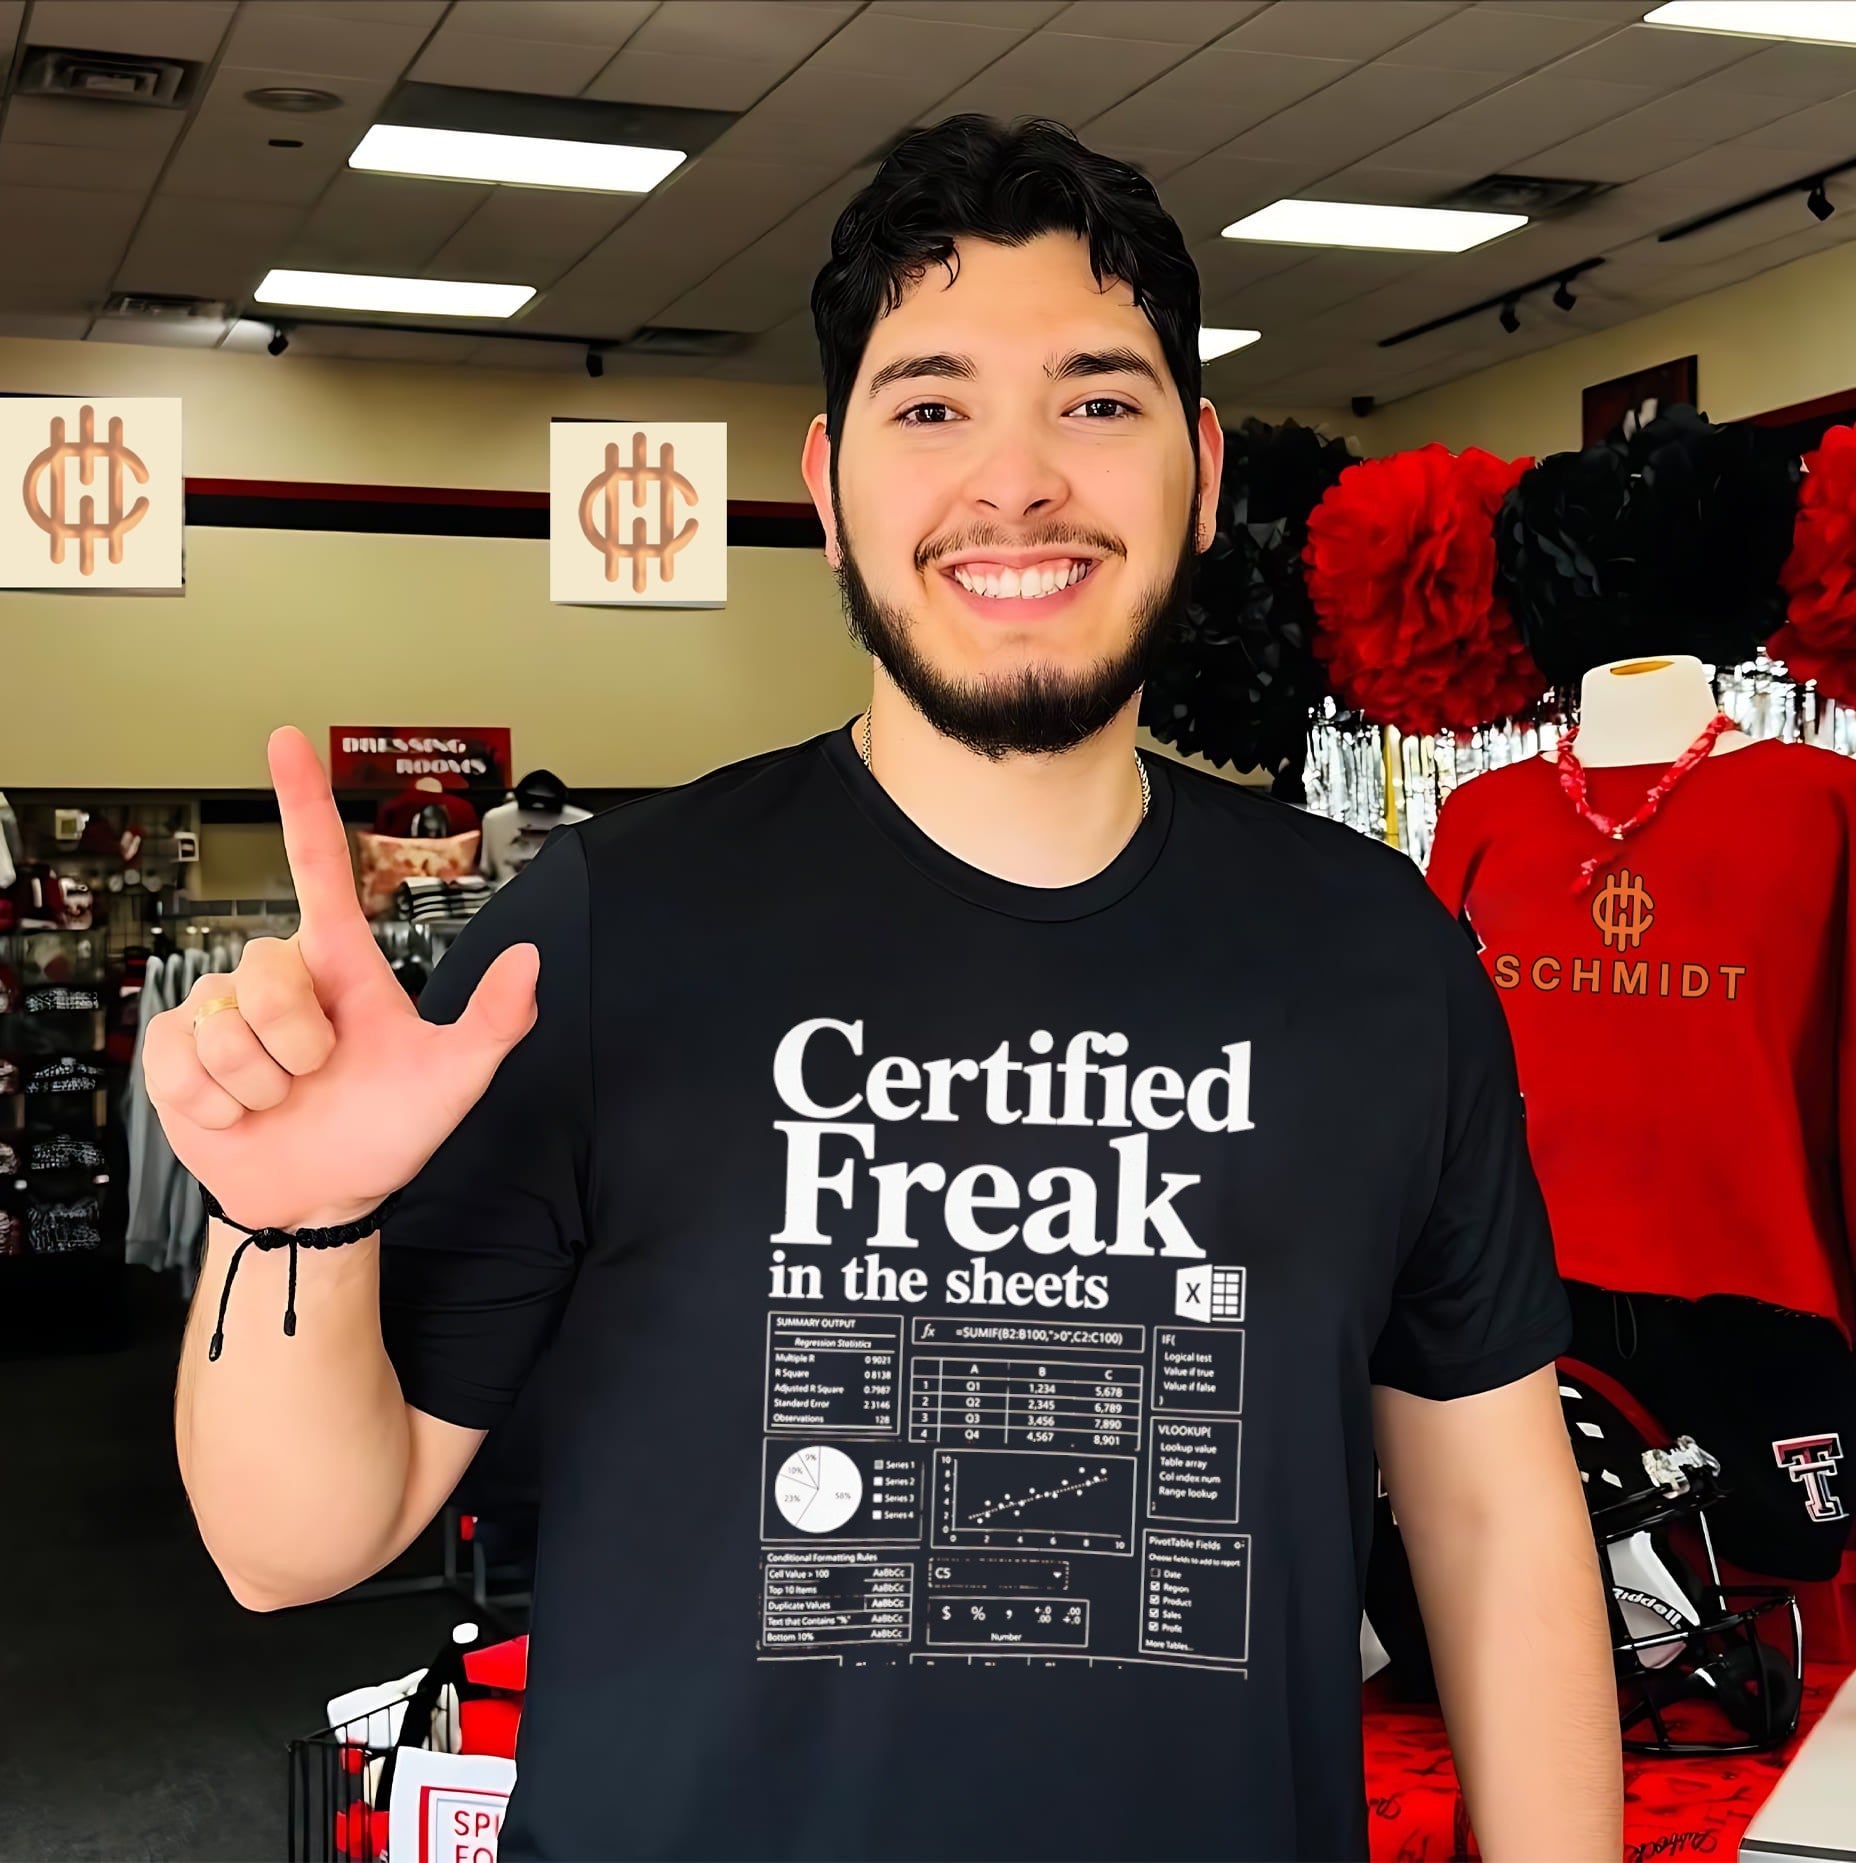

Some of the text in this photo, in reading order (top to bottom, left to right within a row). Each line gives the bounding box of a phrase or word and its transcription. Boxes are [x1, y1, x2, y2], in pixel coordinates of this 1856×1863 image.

[396, 758, 487, 775] ROOMS
[1494, 954, 1746, 1000] SCHMIDT
[773, 1018, 1255, 1133] Certified
[770, 1121, 1206, 1258] Freak
[769, 1251, 1108, 1309] in the sheets
[1185, 1282, 1201, 1304] X
[776, 1318, 856, 1329] SUMMARY OUTPUT
[795, 1338, 872, 1349] Regression Statistics
[1162, 1334, 1176, 1346] IF(
[775, 1354, 891, 1364] Multiple R 09021
[1164, 1352, 1212, 1363] Logical test
[775, 1369, 781, 1377] R
[782, 1369, 809, 1379] Square
[970, 1364, 1113, 1380] A B C
[1164, 1367, 1215, 1378] Value if true
[774, 1384, 808, 1394] Adjusted
[810, 1385, 816, 1393] R
[817, 1385, 844, 1395] Square
[966, 1381, 980, 1391] Q1
[1029, 1384, 1056, 1394] 1,234
[1095, 1387, 1123, 1397] 5,678
[1163, 1382, 1216, 1392] Value if false
[773, 1399, 890, 1409] Standard Error 23146
[922, 1397, 1122, 1414] 2 Q2 2,345 6,789
[773, 1414, 824, 1424] Observations
[921, 1413, 1122, 1430] 3 Q3 3,456 7,890
[921, 1430, 928, 1438] 4
[964, 1430, 980, 1440] Q4
[1026, 1432, 1054, 1443] 4,567
[1158, 1425, 1211, 1438] VLOOKUP(
[1160, 1443, 1217, 1454] Lookup value
[886, 1461, 909, 1469] Series
[942, 1456, 951, 1464] 10
[1160, 1457, 1208, 1469] Table array
[885, 1477, 909, 1486] Series
[1159, 1472, 1221, 1484] Col index num
[944, 1484, 950, 1492] 6
[1158, 1486, 1218, 1500] Range lookup
[885, 1494, 908, 1503] Series
[884, 1511, 908, 1519] Series
[944, 1512, 949, 1520] 2
[950, 1534, 957, 1542] 0
[984, 1535, 990, 1543] 2
[1050, 1537, 1057, 1545] 6
[1083, 1539, 1090, 1547] 8
[1115, 1541, 1125, 1549] 10
[1196, 1540, 1221, 1550] Fields
[767, 1553, 878, 1563] Conditional Formatting Rules
[769, 1569, 784, 1578] Cell
[785, 1569, 806, 1578] Value
[815, 1569, 830, 1578] 100
[873, 1568, 905, 1577] AaBbCc
[1163, 1569, 1182, 1579] Date
[769, 1583, 904, 1595] Top 10 Items AaBbCc
[1163, 1583, 1190, 1593] Region
[768, 1601, 804, 1611] Duplicate
[806, 1601, 831, 1610] Values
[1162, 1597, 1192, 1607] Product
[942, 1605, 951, 1620] $
[970, 1606, 986, 1621] %
[1162, 1610, 1182, 1620] Sales
[768, 1617, 783, 1626] Text
[801, 1616, 836, 1625] Contains
[871, 1614, 903, 1623] AaBbCc
[767, 1629, 902, 1641] Bottom 10% AaBbCc
[991, 1632, 1022, 1642] Number
[1145, 1639, 1165, 1648] More
